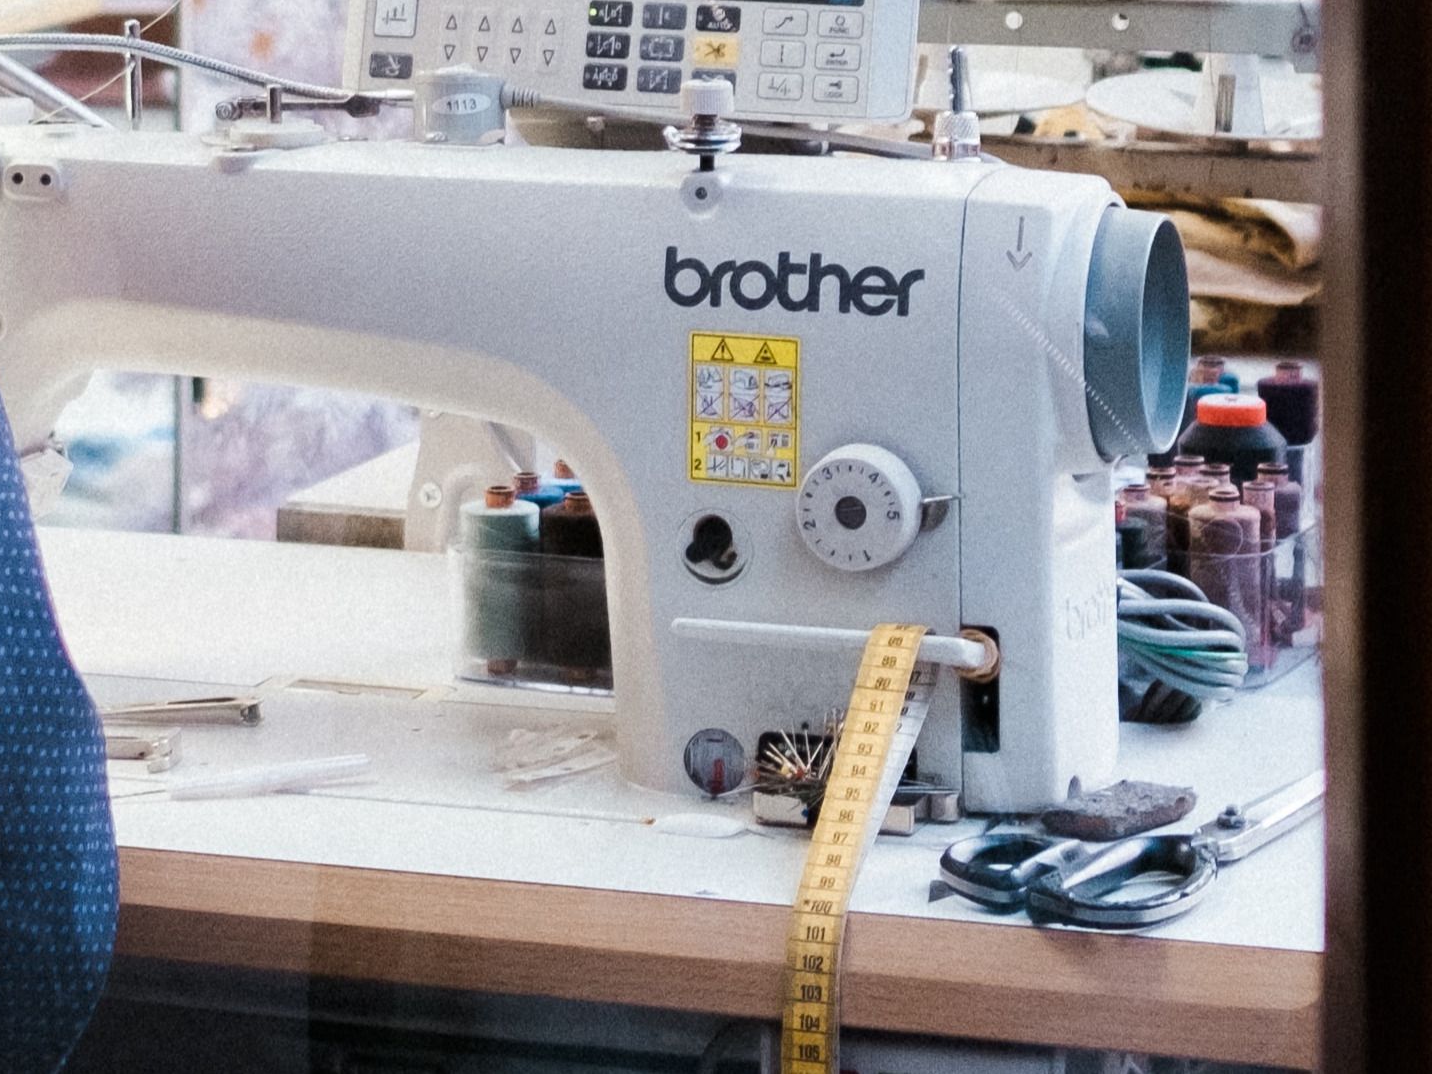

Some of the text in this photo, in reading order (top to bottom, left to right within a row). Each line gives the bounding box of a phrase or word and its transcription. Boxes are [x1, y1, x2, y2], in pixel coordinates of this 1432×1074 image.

[447, 98, 477, 111] 1113
[664, 245, 925, 317] brother
[695, 431, 701, 444] 1
[694, 458, 702, 471] 2
[822, 467, 833, 480] 3
[868, 472, 880, 484] 4
[886, 510, 900, 520] 5
[803, 519, 817, 530] 2
[832, 831, 848, 845] 97
[820, 876, 836, 887] 99
[806, 926, 826, 941] 101
[802, 954, 823, 973] 102
[800, 984, 822, 1001] 103
[799, 1013, 820, 1031] 104
[798, 1044, 820, 1061] 105
